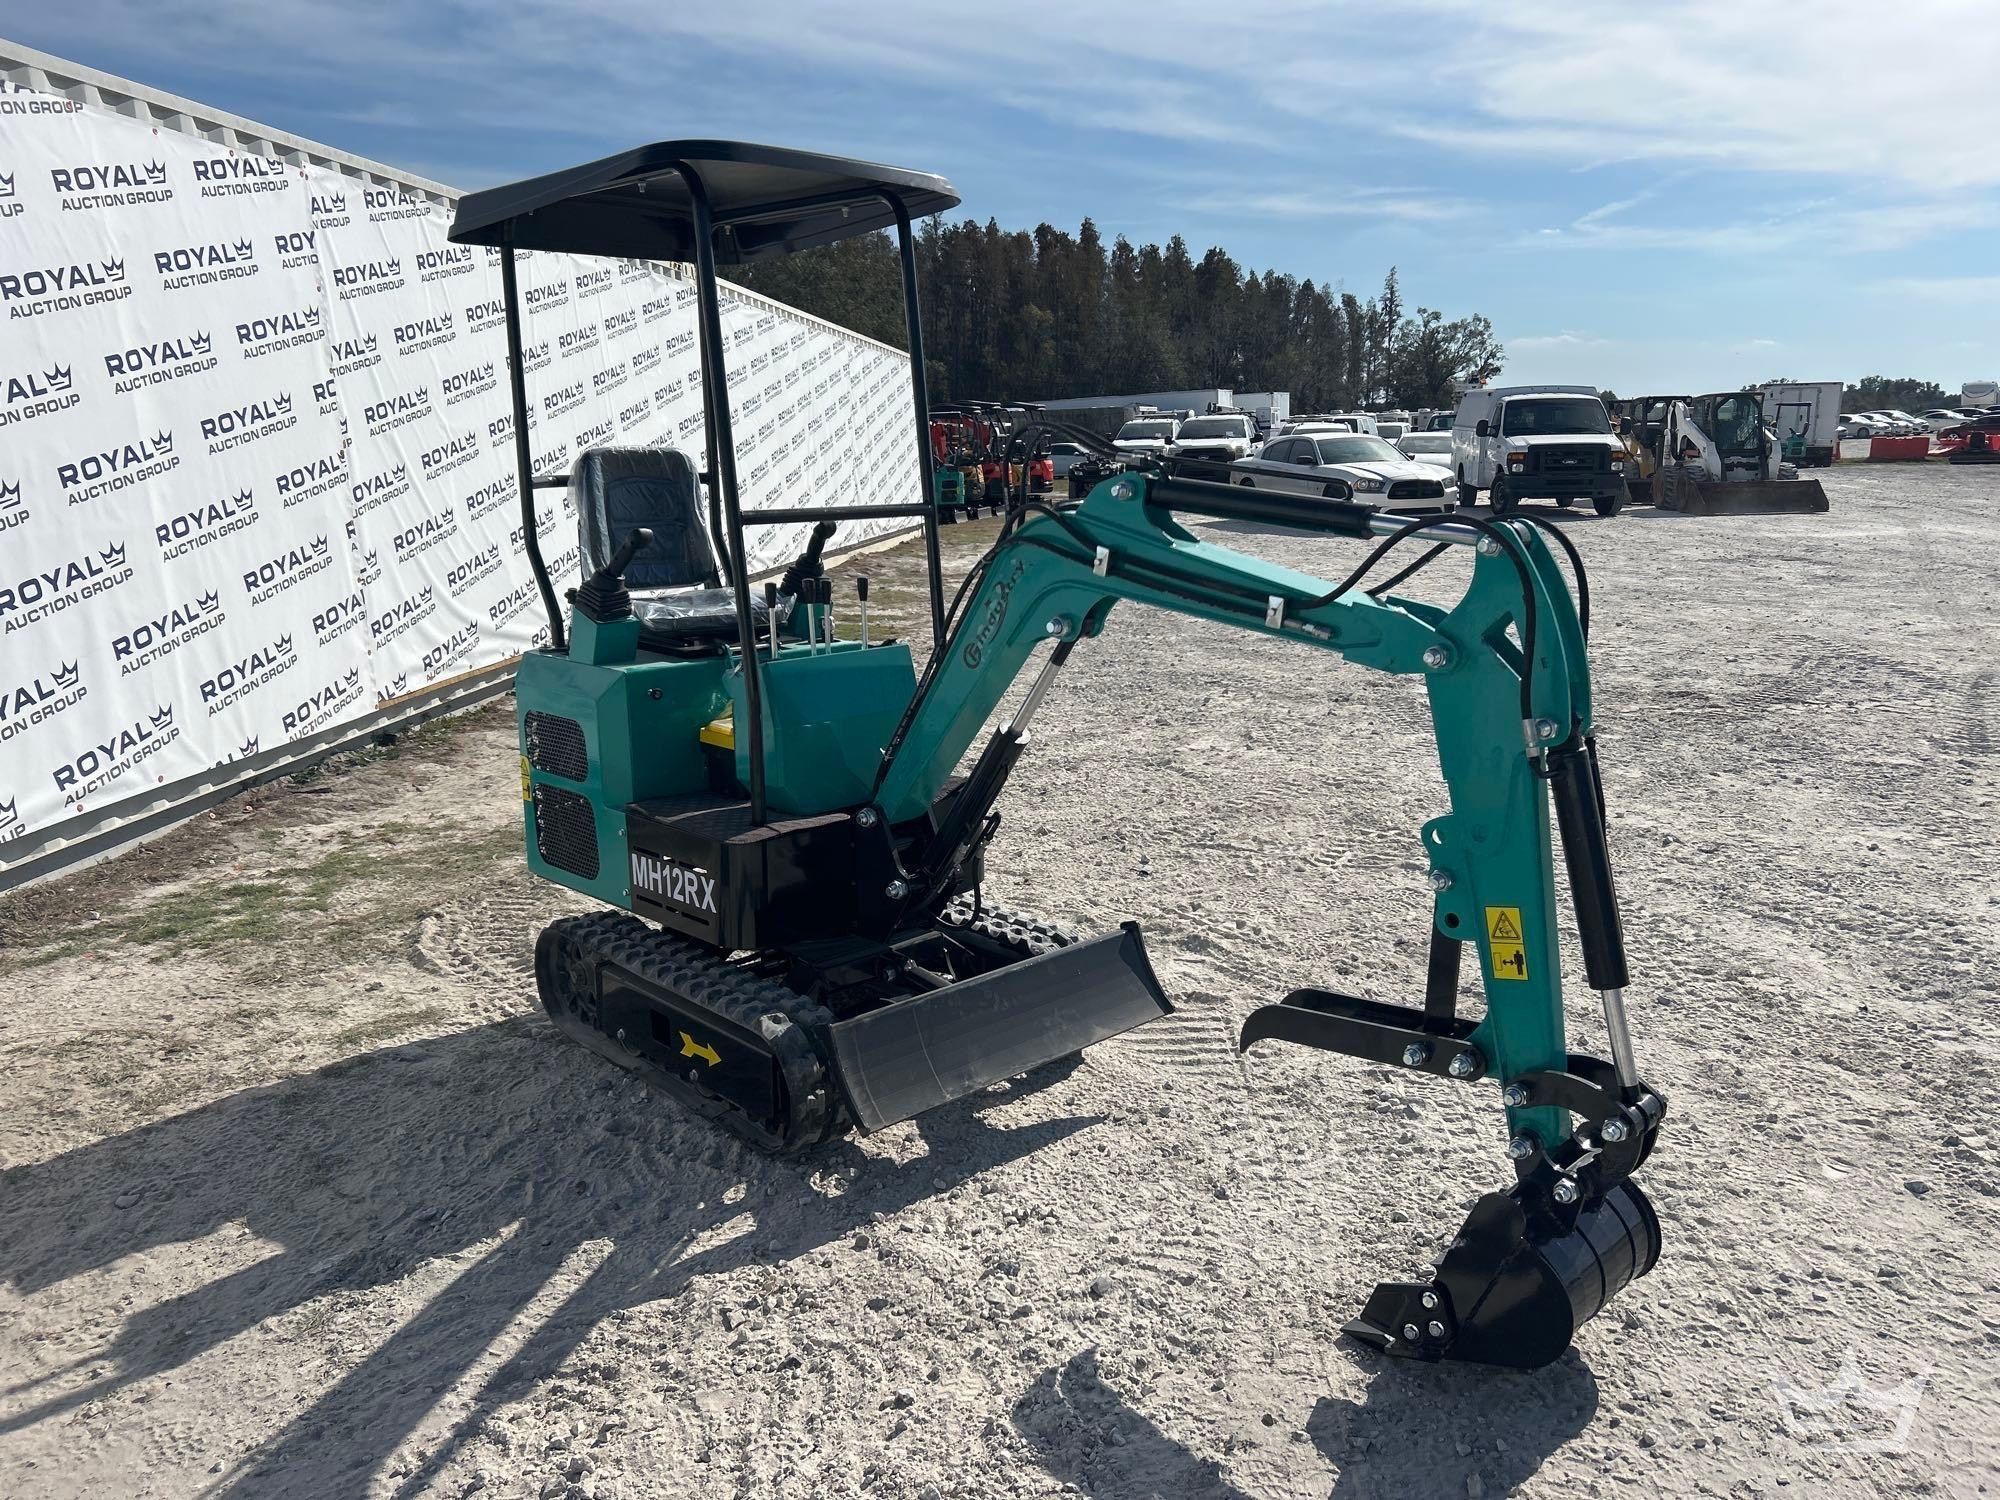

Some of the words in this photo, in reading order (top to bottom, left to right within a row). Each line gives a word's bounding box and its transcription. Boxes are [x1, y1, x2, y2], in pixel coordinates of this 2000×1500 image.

[29, 101, 83, 114] GROUP
[50, 164, 150, 192] ROYAL
[193, 157, 270, 181] ROYAL
[61, 194, 127, 211] AUCTION
[127, 189, 175, 204] GROUP
[202, 183, 252, 197] AUCTION
[252, 180, 290, 192] GROUP
[320, 216, 350, 229] GROUP
[369, 210, 405, 222] AUCTION
[405, 207, 431, 218] GROUP
[154, 243, 239, 274] ROYAL
[275, 231, 315, 254] ROY
[282, 254, 319, 269] AUCTIO
[332, 261, 390, 287] ROYAL
[415, 248, 463, 271] ROYAL
[421, 269, 452, 283] AUCTION
[451, 264, 475, 276] GROUP
[0, 263, 108, 300] ROYAL
[164, 271, 219, 291] AUCTION
[219, 264, 260, 280] GROUP
[339, 285, 377, 301] AUCTION
[376, 278, 405, 292] GROUP
[575, 270, 605, 290] ROYAL
[11, 295, 83, 319] AUCTION
[83, 286, 136, 305] GROUP
[525, 284, 560, 305] ROYAL
[642, 298, 665, 316] ROYAL
[465, 299, 506, 323] ROYAL
[470, 319, 497, 334] AUCTION
[604, 312, 631, 331] ROYAL
[236, 312, 308, 345] ROYAL
[244, 339, 291, 360] AUCTION
[291, 329, 326, 346] GROUP
[393, 317, 444, 344] ROYAL
[399, 339, 432, 357] AUCTION
[431, 332, 457, 346] GROUP
[559, 327, 590, 349] ROYAL
[666, 332, 688, 351] ROYAL
[103, 338, 195, 377] ROYAL
[332, 339, 365, 361] YAL
[352, 354, 382, 371] GROUP
[631, 348, 656, 368] ROYAL
[114, 369, 174, 394] AUCTION
[174, 357, 218, 377] GROUP
[442, 367, 486, 395] ROYAL
[592, 366, 621, 388] ROYAL
[23, 393, 81, 418] GROUP
[447, 388, 476, 407] AUCTION
[475, 379, 497, 394] GROUP
[543, 386, 577, 411] ROYAL
[654, 382, 677, 403] ROYAL
[200, 401, 278, 440] ROYAL
[364, 393, 418, 425] ROYAL
[370, 416, 405, 438] AUCTION
[405, 406, 432, 423] GROUP
[619, 402, 645, 424] ROYAL
[210, 429, 260, 456] AUCTION
[260, 416, 298, 436] GROUP
[576, 424, 606, 449] ROYAL
[57, 440, 158, 488] ROYAL
[420, 438, 468, 470] ROYAL
[426, 461, 457, 482] AUCTION
[456, 449, 480, 466] GROUP
[69, 474, 135, 506] AUCTION
[135, 456, 183, 481] GROUP
[276, 455, 340, 495] ROYAL
[283, 482, 327, 509] AUCTION
[328, 472, 349, 489] GRO
[352, 472, 394, 503] OYAL
[381, 483, 410, 503] GROUP
[465, 480, 507, 512] ROYAL
[153, 499, 238, 547] ROYAL
[163, 530, 219, 563] AUCTION
[218, 512, 259, 537] GROUP
[393, 516, 443, 553] ROYAL
[399, 540, 432, 565] AUCTION
[431, 525, 456, 545] GROUP
[243, 545, 315, 592] ROYAL
[251, 575, 298, 607] AUCTION
[298, 556, 333, 580] GROUP
[446, 552, 490, 588] ROYAL
[451, 574, 480, 599] AUCTION
[479, 560, 502, 579] GROUP
[0, 556, 106, 615] ROYAL
[7, 592, 80, 634] AUCTION
[80, 568, 134, 599] GROUP
[369, 596, 423, 639] ROYAL
[489, 586, 528, 622] ROYAL
[111, 603, 203, 661] ROYAL
[319, 615, 358, 648] AUCTION
[375, 622, 410, 651] AUCTION
[410, 603, 436, 626] GROUP
[122, 637, 182, 677] AUCTION
[182, 613, 227, 643] GROUP
[421, 630, 468, 672] ROYAL
[427, 655, 458, 684] AUCTION
[457, 637, 480, 659] GROUP
[200, 647, 278, 702] ROYAL
[210, 679, 261, 717] AUCTION
[260, 654, 298, 683] GROUP
[0, 679, 55, 721] YAL
[30, 686, 88, 725] GROUP
[282, 681, 347, 733] ROYAL
[333, 686, 364, 714] GROUP
[54, 722, 155, 791] ROYAL
[65, 759, 132, 808] AUCTION
[132, 728, 181, 764] GROUP
[632, 853, 717, 913] MH12RX
